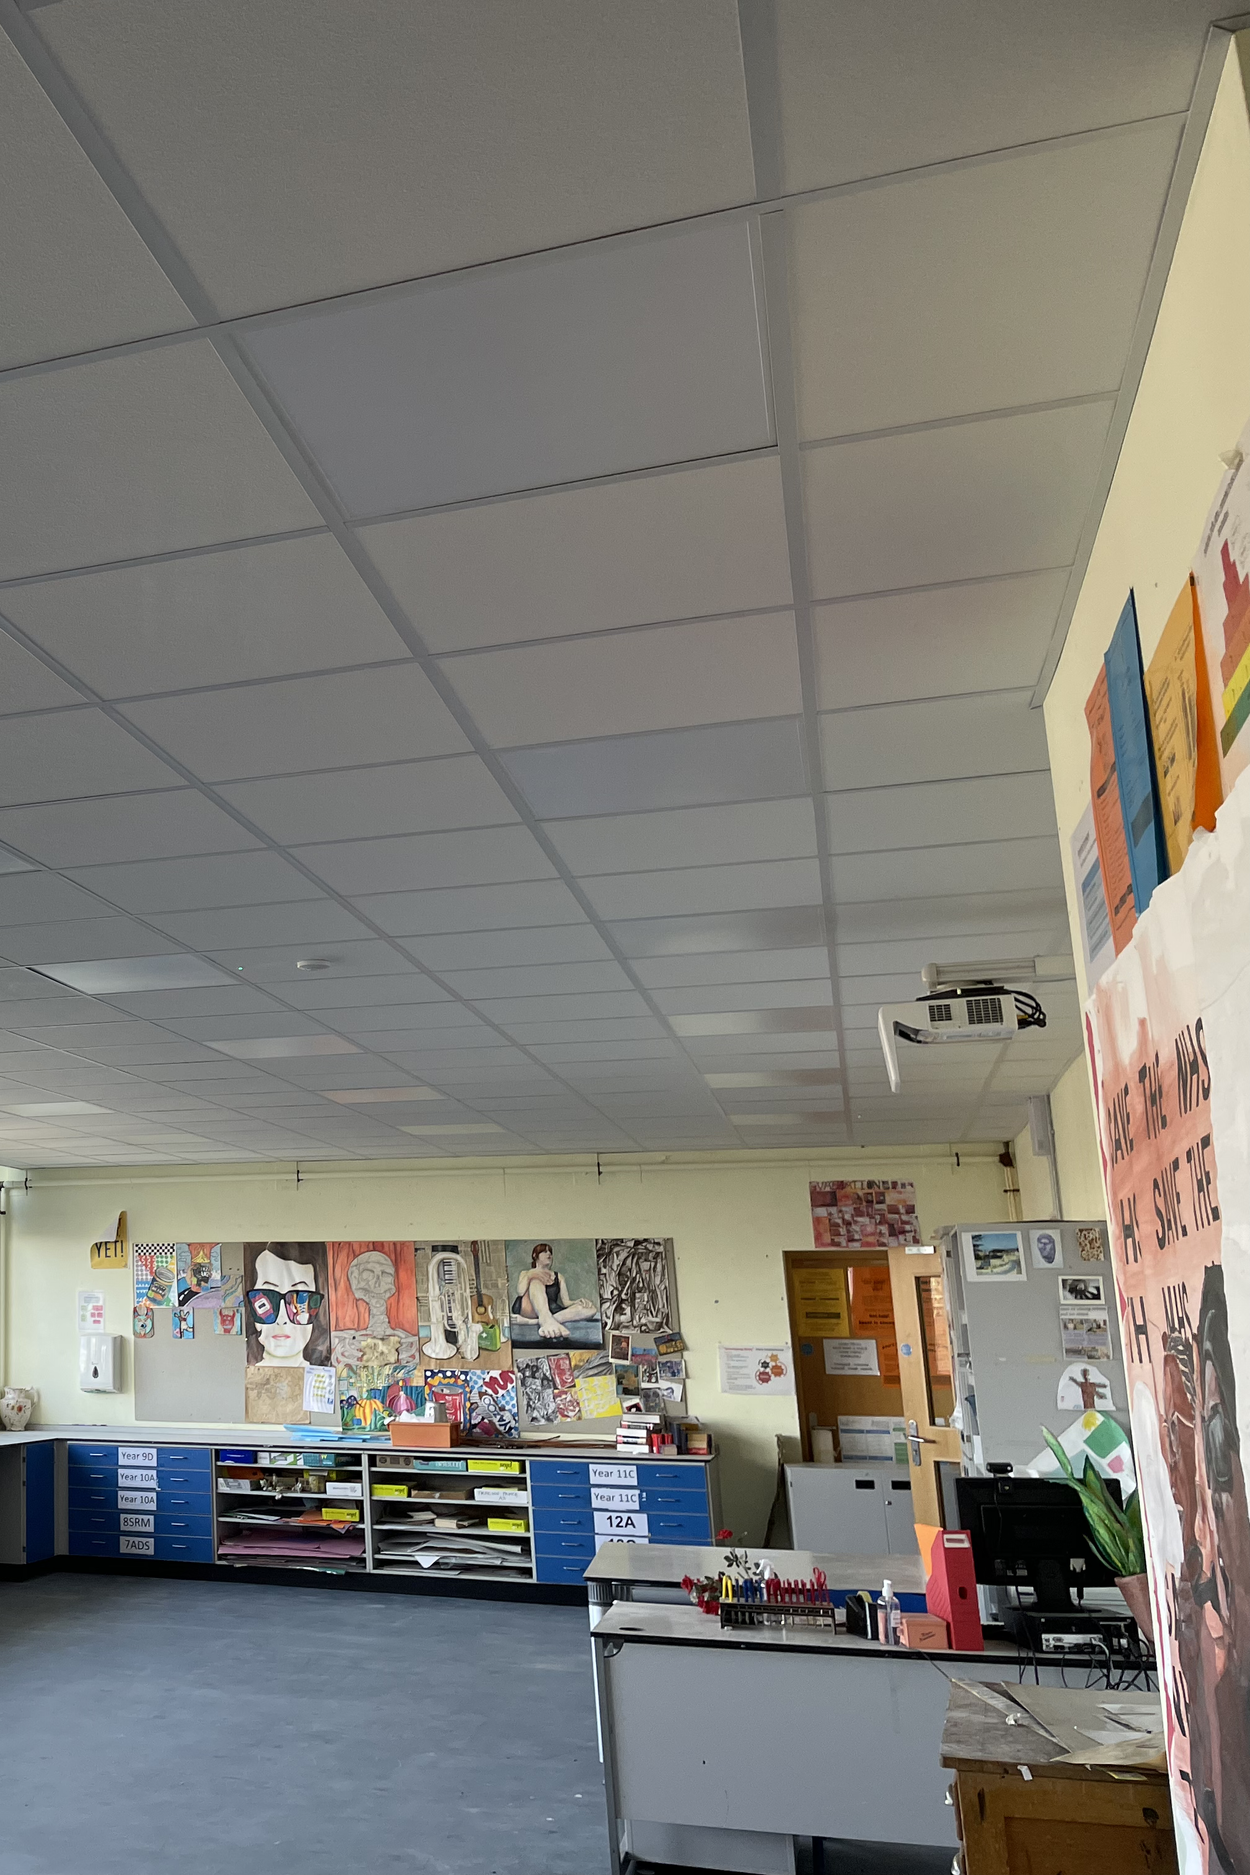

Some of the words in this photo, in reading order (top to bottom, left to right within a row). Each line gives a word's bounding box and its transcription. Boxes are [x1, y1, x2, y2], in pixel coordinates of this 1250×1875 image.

[1107, 1082, 1134, 1171] SAVE
[1138, 1050, 1168, 1140] THE
[1175, 1017, 1211, 1117] NHS
[1152, 1156, 1188, 1251] SAVE
[1185, 1132, 1220, 1232] THE
[95, 1240, 124, 1258] YET!
[121, 1451, 140, 1461] Year
[141, 1452, 154, 1461] 9D
[120, 1472, 138, 1481] Year
[140, 1473, 156, 1482] 10A
[592, 1468, 614, 1478] Year
[617, 1469, 635, 1479] 11C
[120, 1494, 138, 1503] Year
[140, 1495, 155, 1504] 10A
[594, 1492, 616, 1502] Year
[618, 1493, 637, 1503] 11C
[123, 1517, 151, 1528] 8SRM
[606, 1514, 636, 1529] 12A
[124, 1539, 150, 1551] 7ADS
